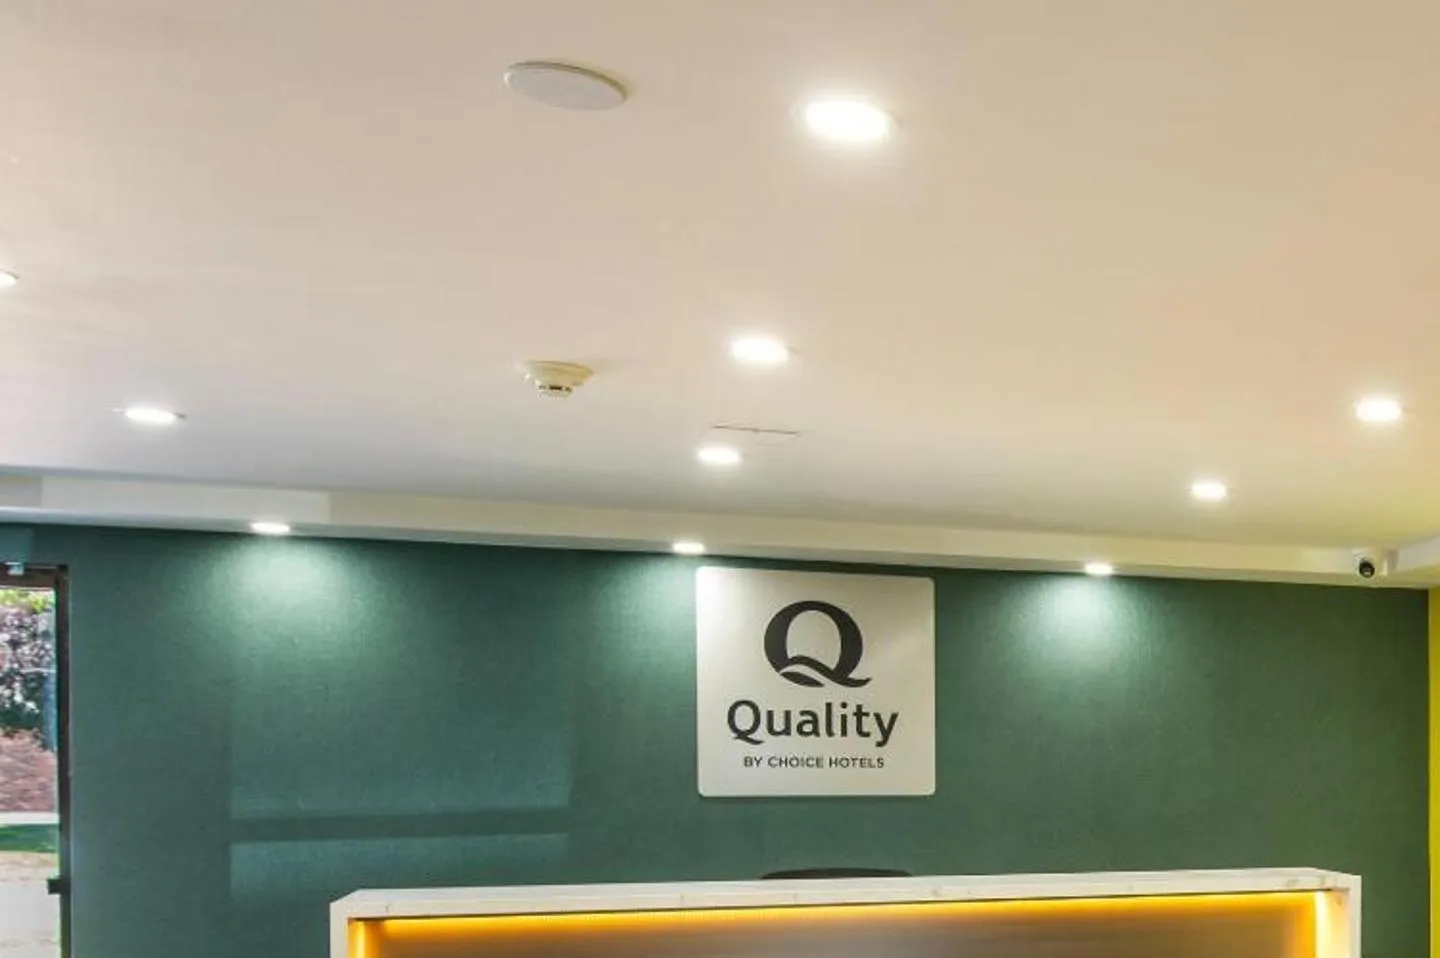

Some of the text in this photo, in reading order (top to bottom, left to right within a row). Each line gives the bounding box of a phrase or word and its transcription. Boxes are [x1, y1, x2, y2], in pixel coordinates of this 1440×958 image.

[763, 600, 872, 688] Q
[727, 699, 899, 748] Quality
[743, 756, 885, 769] BY CHOICE HOTELS
